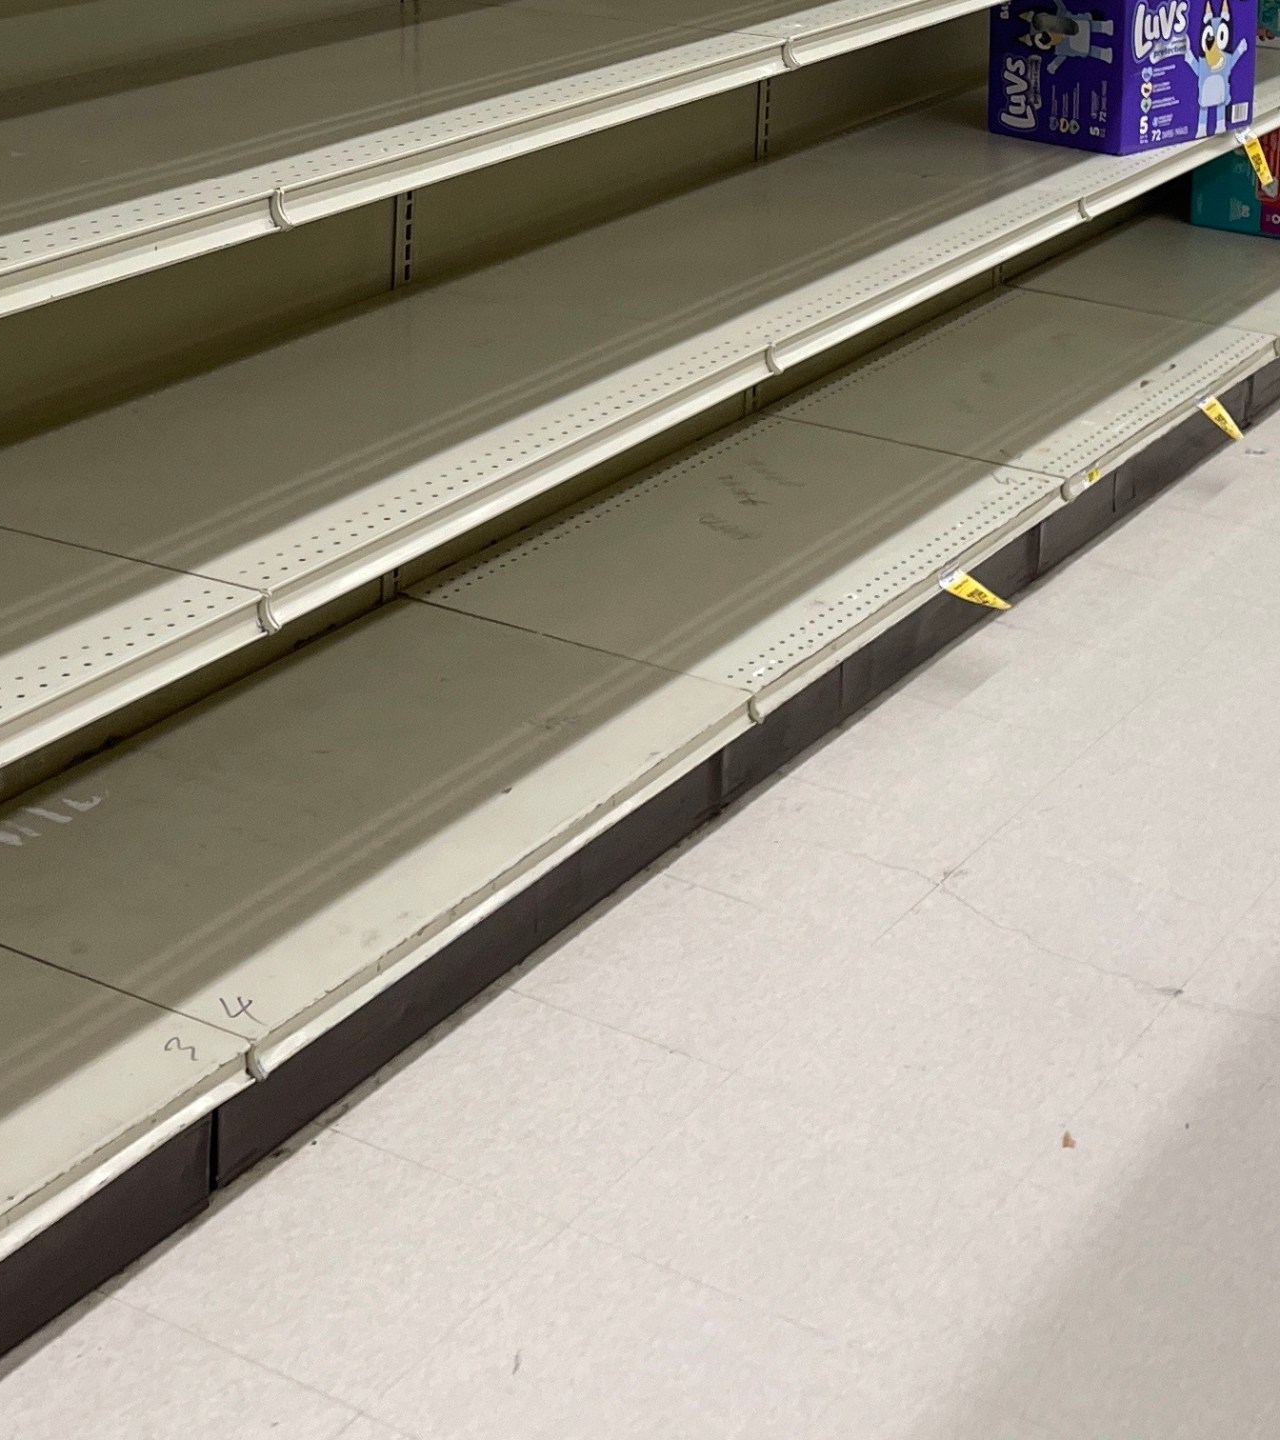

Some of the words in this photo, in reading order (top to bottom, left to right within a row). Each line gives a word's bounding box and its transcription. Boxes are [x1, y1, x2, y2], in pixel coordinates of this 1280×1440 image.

[1140, 116, 1149, 134] 5
[1151, 129, 1162, 141] 72
[219, 996, 268, 1026] 4
